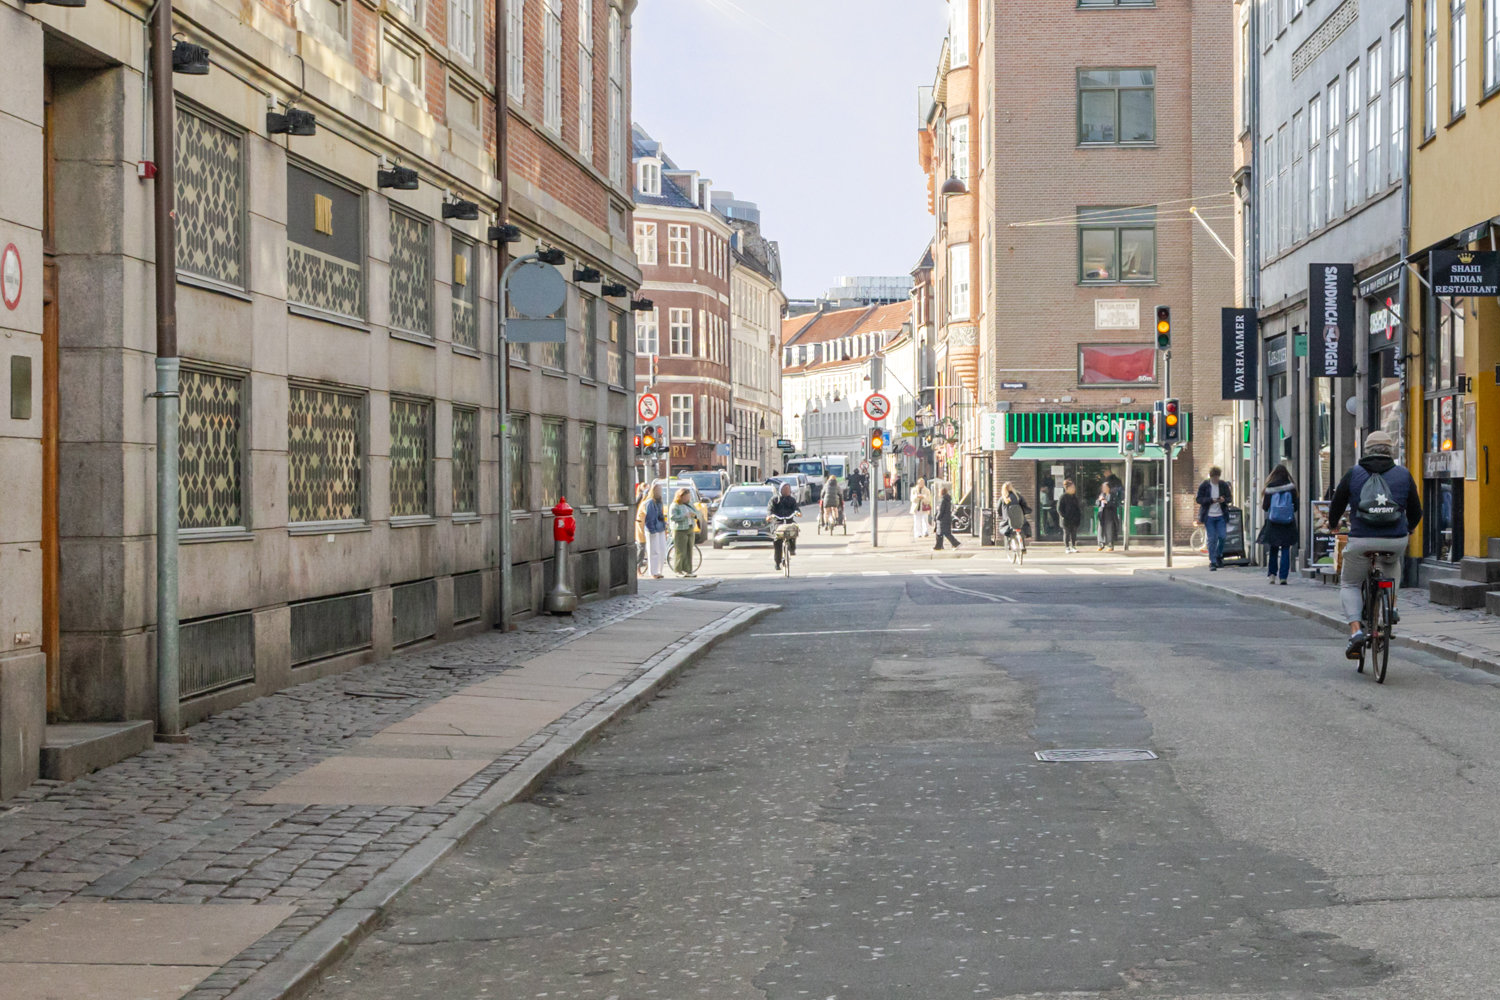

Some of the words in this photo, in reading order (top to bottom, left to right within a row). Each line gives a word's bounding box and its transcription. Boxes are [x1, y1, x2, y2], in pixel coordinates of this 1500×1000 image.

[1451, 265, 1481, 273] SHAHI
[1450, 275, 1483, 283] INDIAN
[1435, 285, 1498, 293] RESTAURANT
[1324, 266, 1338, 326] SANDWICH
[1234, 314, 1245, 393] WARHAMMER
[1325, 341, 1338, 375] PIGEN
[1054, 423, 1079, 435] THE
